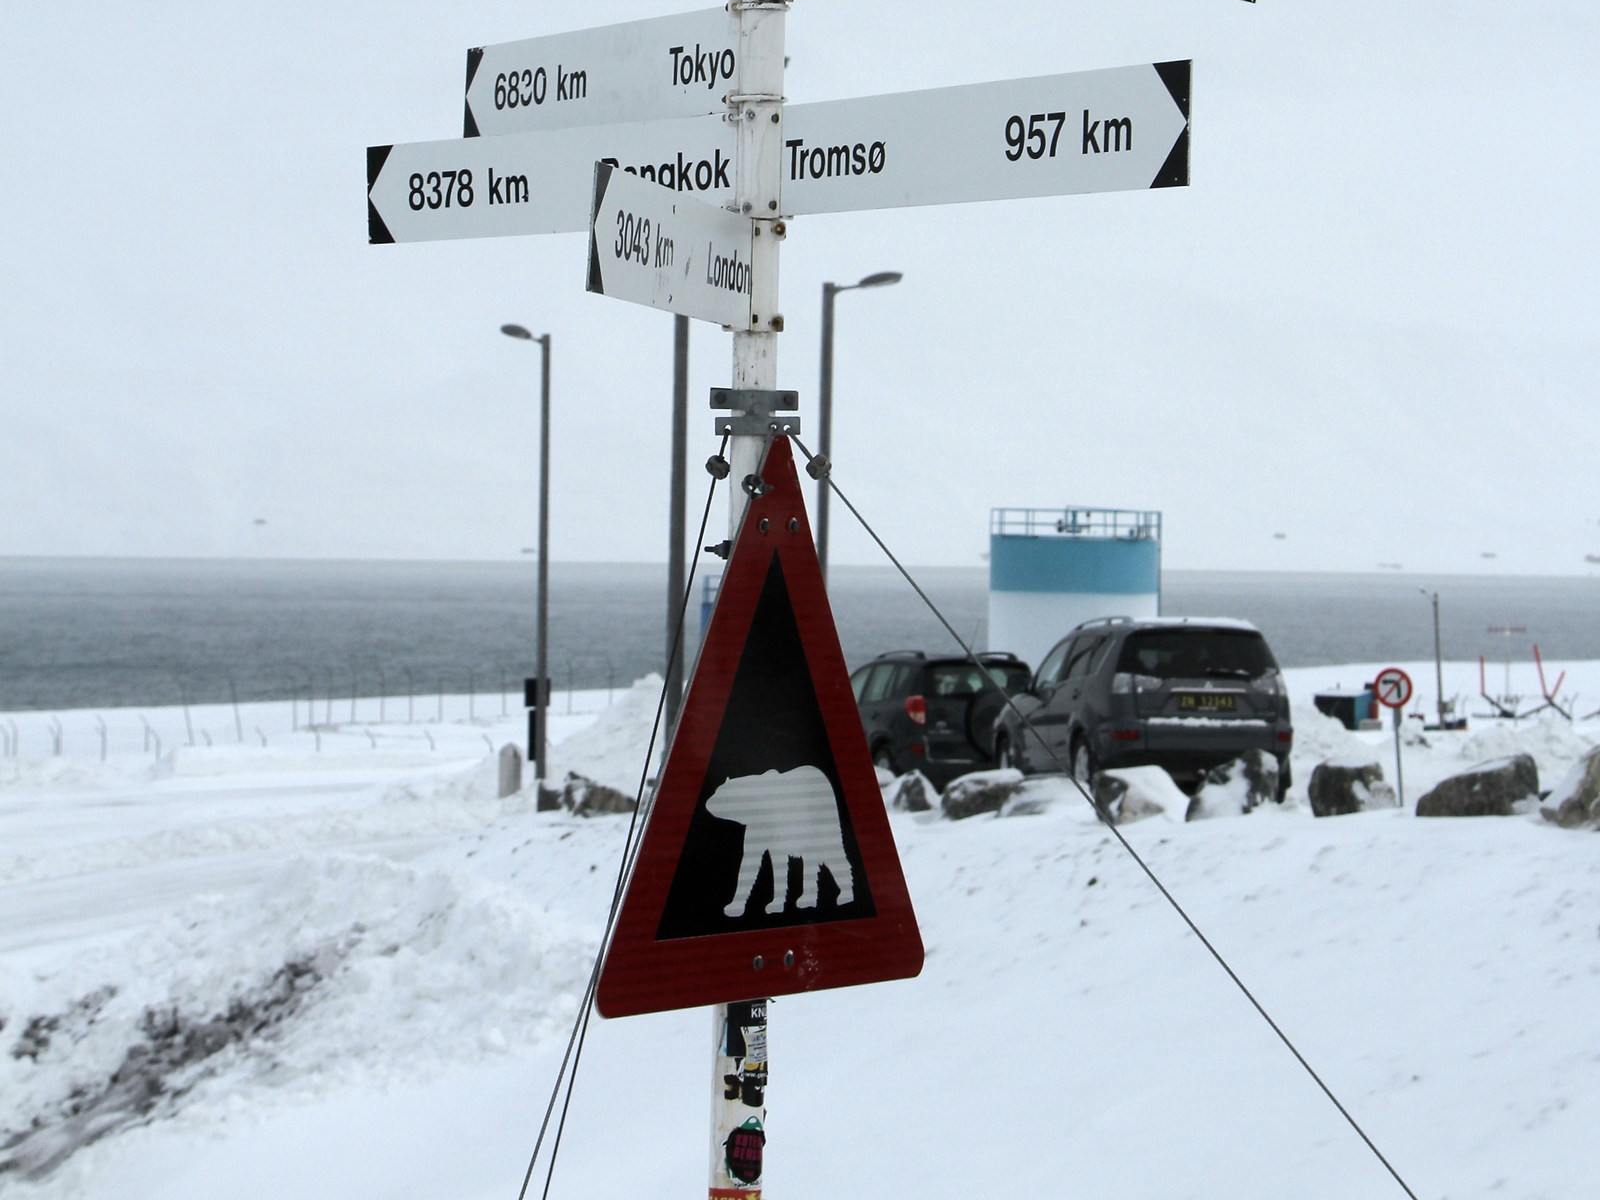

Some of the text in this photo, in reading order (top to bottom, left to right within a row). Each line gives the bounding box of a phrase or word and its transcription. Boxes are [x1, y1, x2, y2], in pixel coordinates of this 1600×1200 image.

[493, 43, 735, 111] 6830 km Tokyo
[408, 148, 731, 211] 8378 km ngkok
[785, 109, 1133, 181] Tromsø 957 km
[614, 209, 750, 295] 3043 km London
